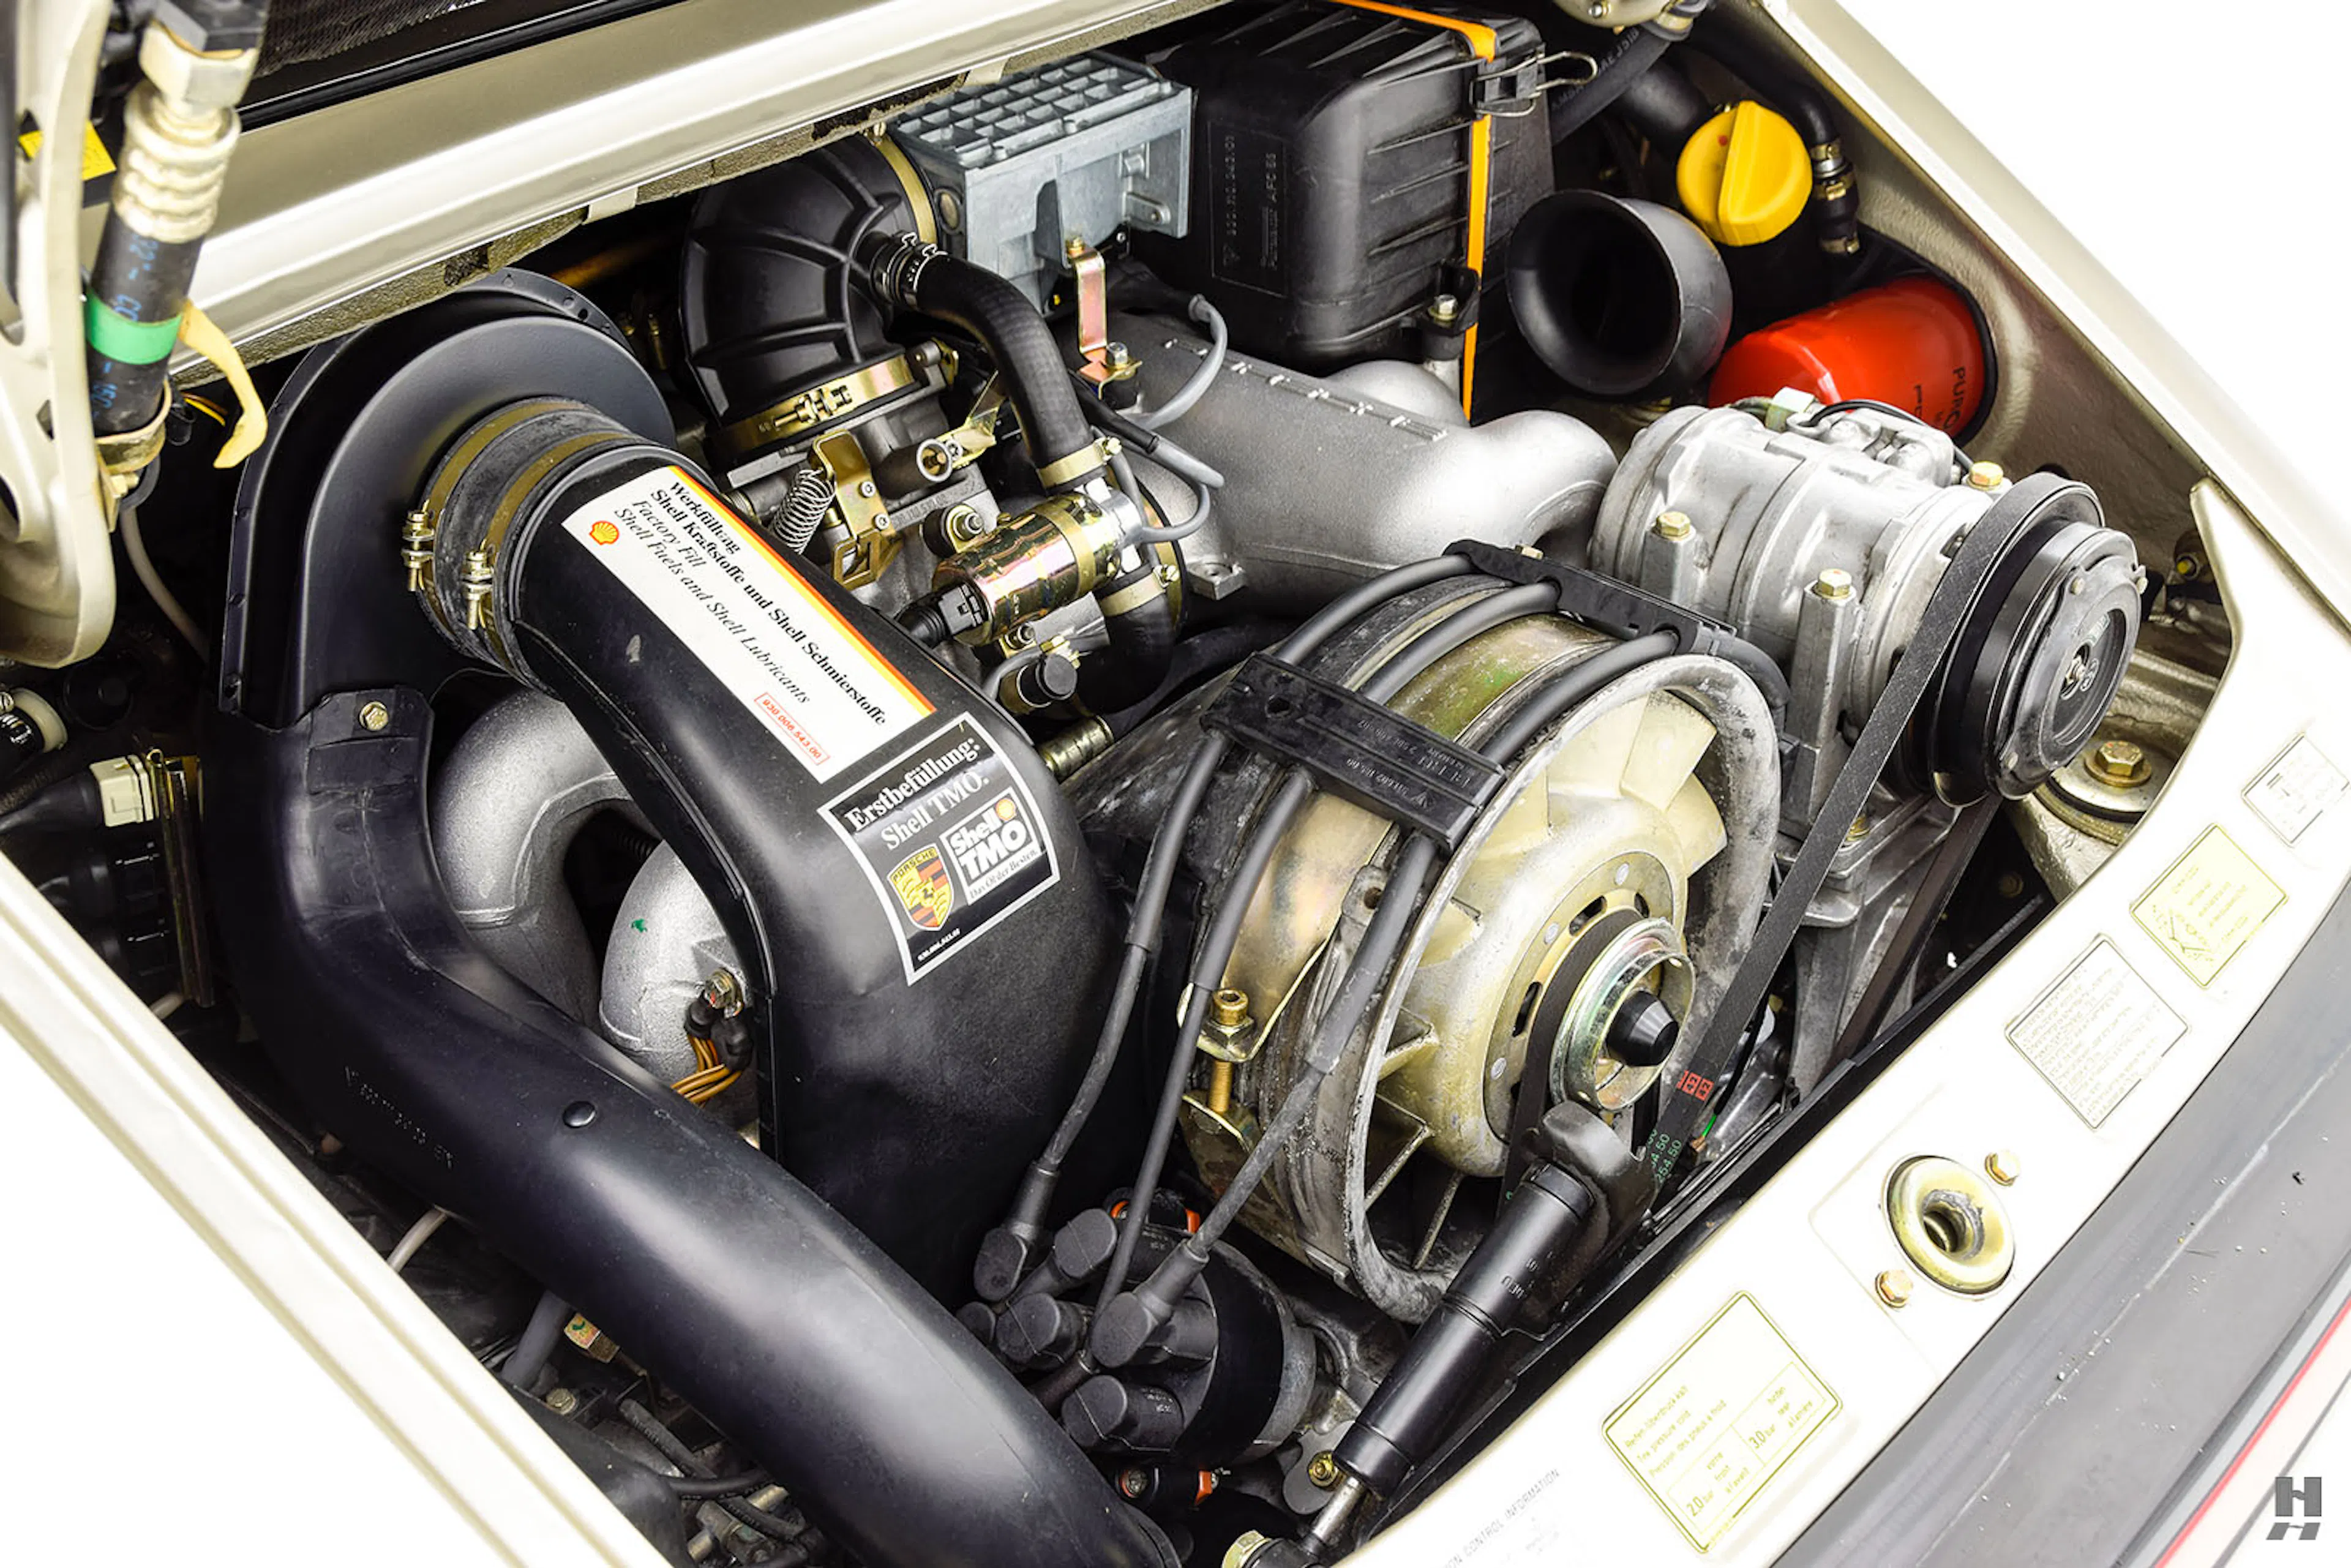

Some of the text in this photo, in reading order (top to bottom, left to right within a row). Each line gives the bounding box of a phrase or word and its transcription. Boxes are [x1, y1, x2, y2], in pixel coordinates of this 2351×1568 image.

[633, 501, 706, 566] Factory Fill
[671, 482, 740, 553] Werkfüllung
[615, 509, 810, 703] Shell Fuels and Shell Lubricants
[651, 490, 885, 724] Shell Kraftstoffe und Shell Schmierstoffe
[846, 738, 980, 831] Erstbefüllung:
[880, 770, 989, 849] Shell TMO.
[893, 849, 937, 882] PORSCHE
[951, 808, 998, 853] Shell
[960, 820, 1027, 880] TMO
